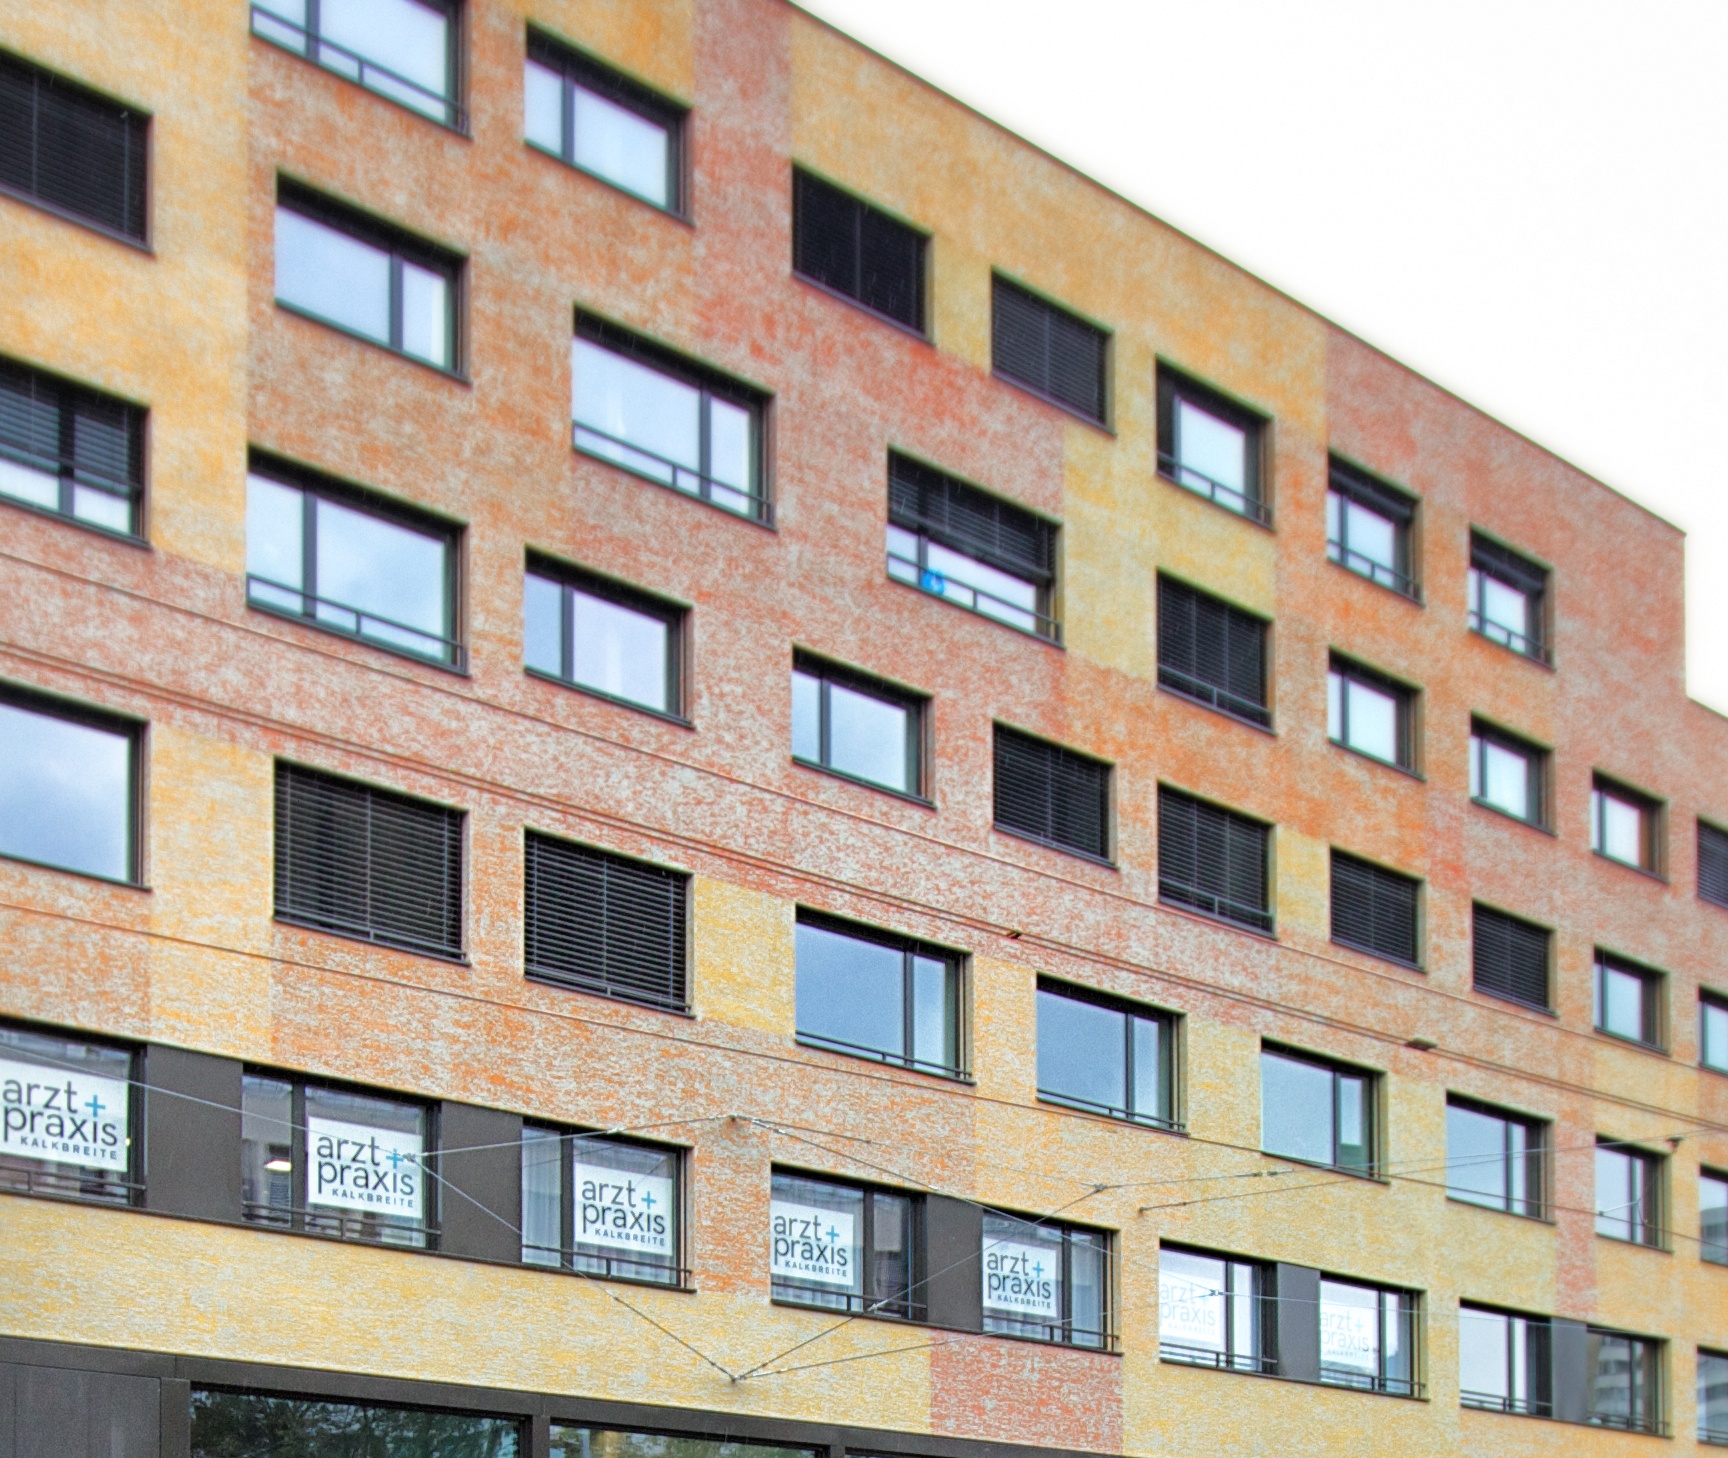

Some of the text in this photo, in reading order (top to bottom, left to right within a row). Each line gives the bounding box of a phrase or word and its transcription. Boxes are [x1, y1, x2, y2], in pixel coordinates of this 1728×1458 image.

[3, 1106, 117, 1147] praxis
[20, 1136, 118, 1160] KALKBREITE
[317, 1161, 414, 1195] praxis
[332, 1188, 414, 1208] KALKBREITE
[582, 1203, 665, 1234] praxis
[595, 1228, 665, 1246] KALKBREITE
[774, 1237, 847, 1267] praxis
[988, 1272, 1051, 1299] praxis
[1160, 1303, 1216, 1326] praxis
